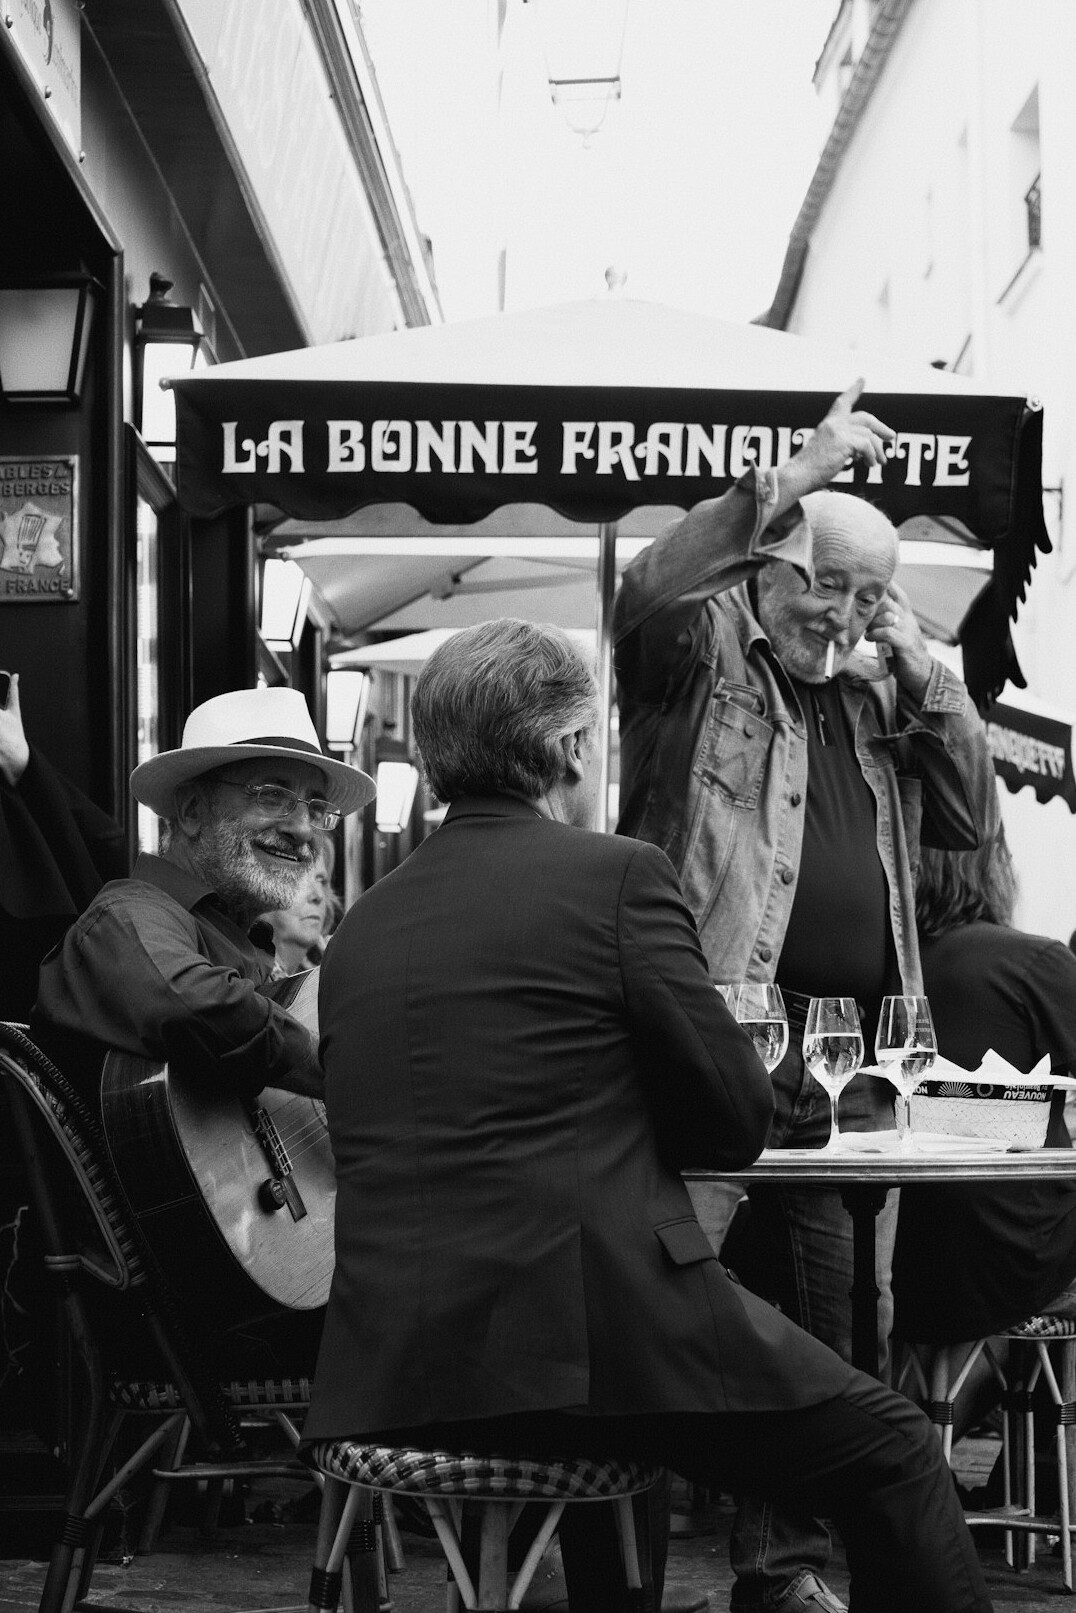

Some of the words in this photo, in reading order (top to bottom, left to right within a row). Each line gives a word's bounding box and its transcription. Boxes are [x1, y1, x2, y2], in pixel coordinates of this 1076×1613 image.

[221, 420, 305, 474] LA
[326, 420, 539, 475] BONNE
[6, 578, 70, 594] FRANCE
[1003, 1090, 1047, 1101] NOUVEAU
